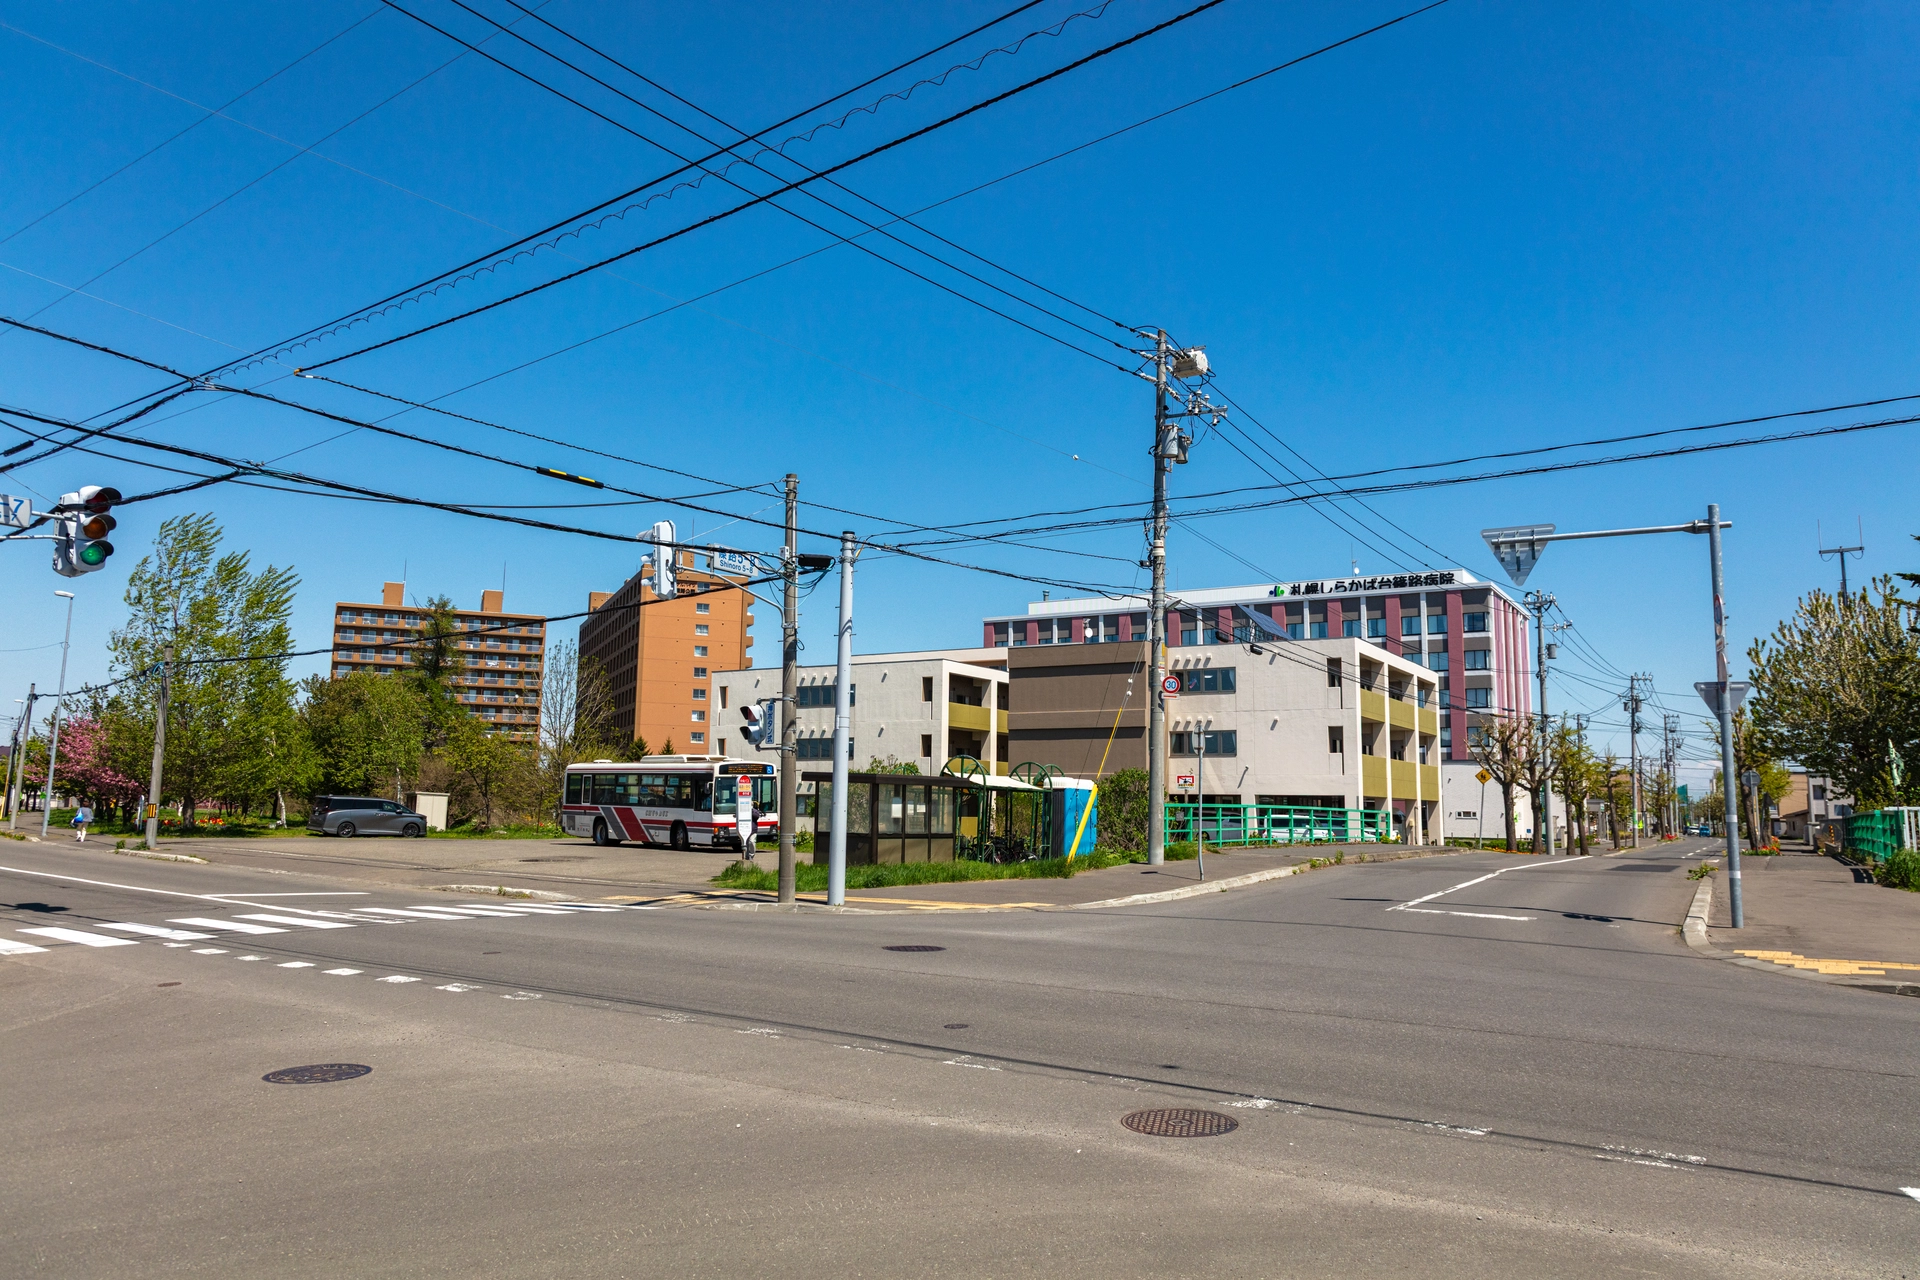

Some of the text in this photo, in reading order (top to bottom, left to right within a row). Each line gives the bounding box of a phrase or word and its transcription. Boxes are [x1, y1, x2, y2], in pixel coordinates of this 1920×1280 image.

[720, 560, 754, 574] Shinoro 5-8
[1290, 572, 1455, 596] 札幌しらかば台篠路病院
[1166, 680, 1177, 689] 30
